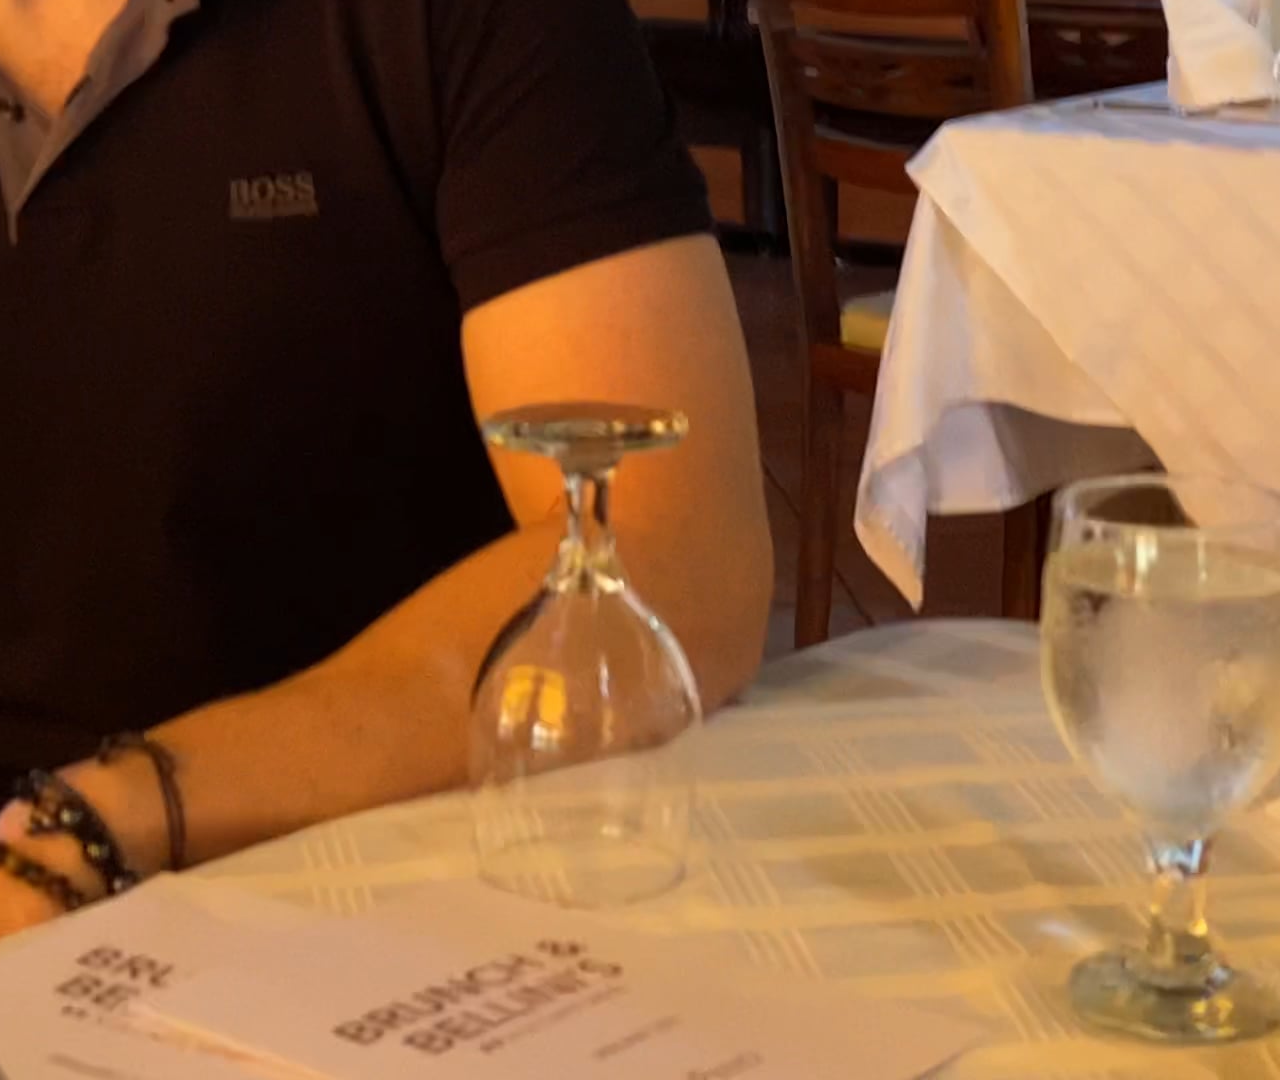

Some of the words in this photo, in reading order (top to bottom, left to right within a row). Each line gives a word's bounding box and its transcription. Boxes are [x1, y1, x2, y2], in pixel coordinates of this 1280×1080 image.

[229, 172, 315, 204] BOSS
[331, 953, 545, 1046] BRUNCH
[536, 939, 586, 958] &
